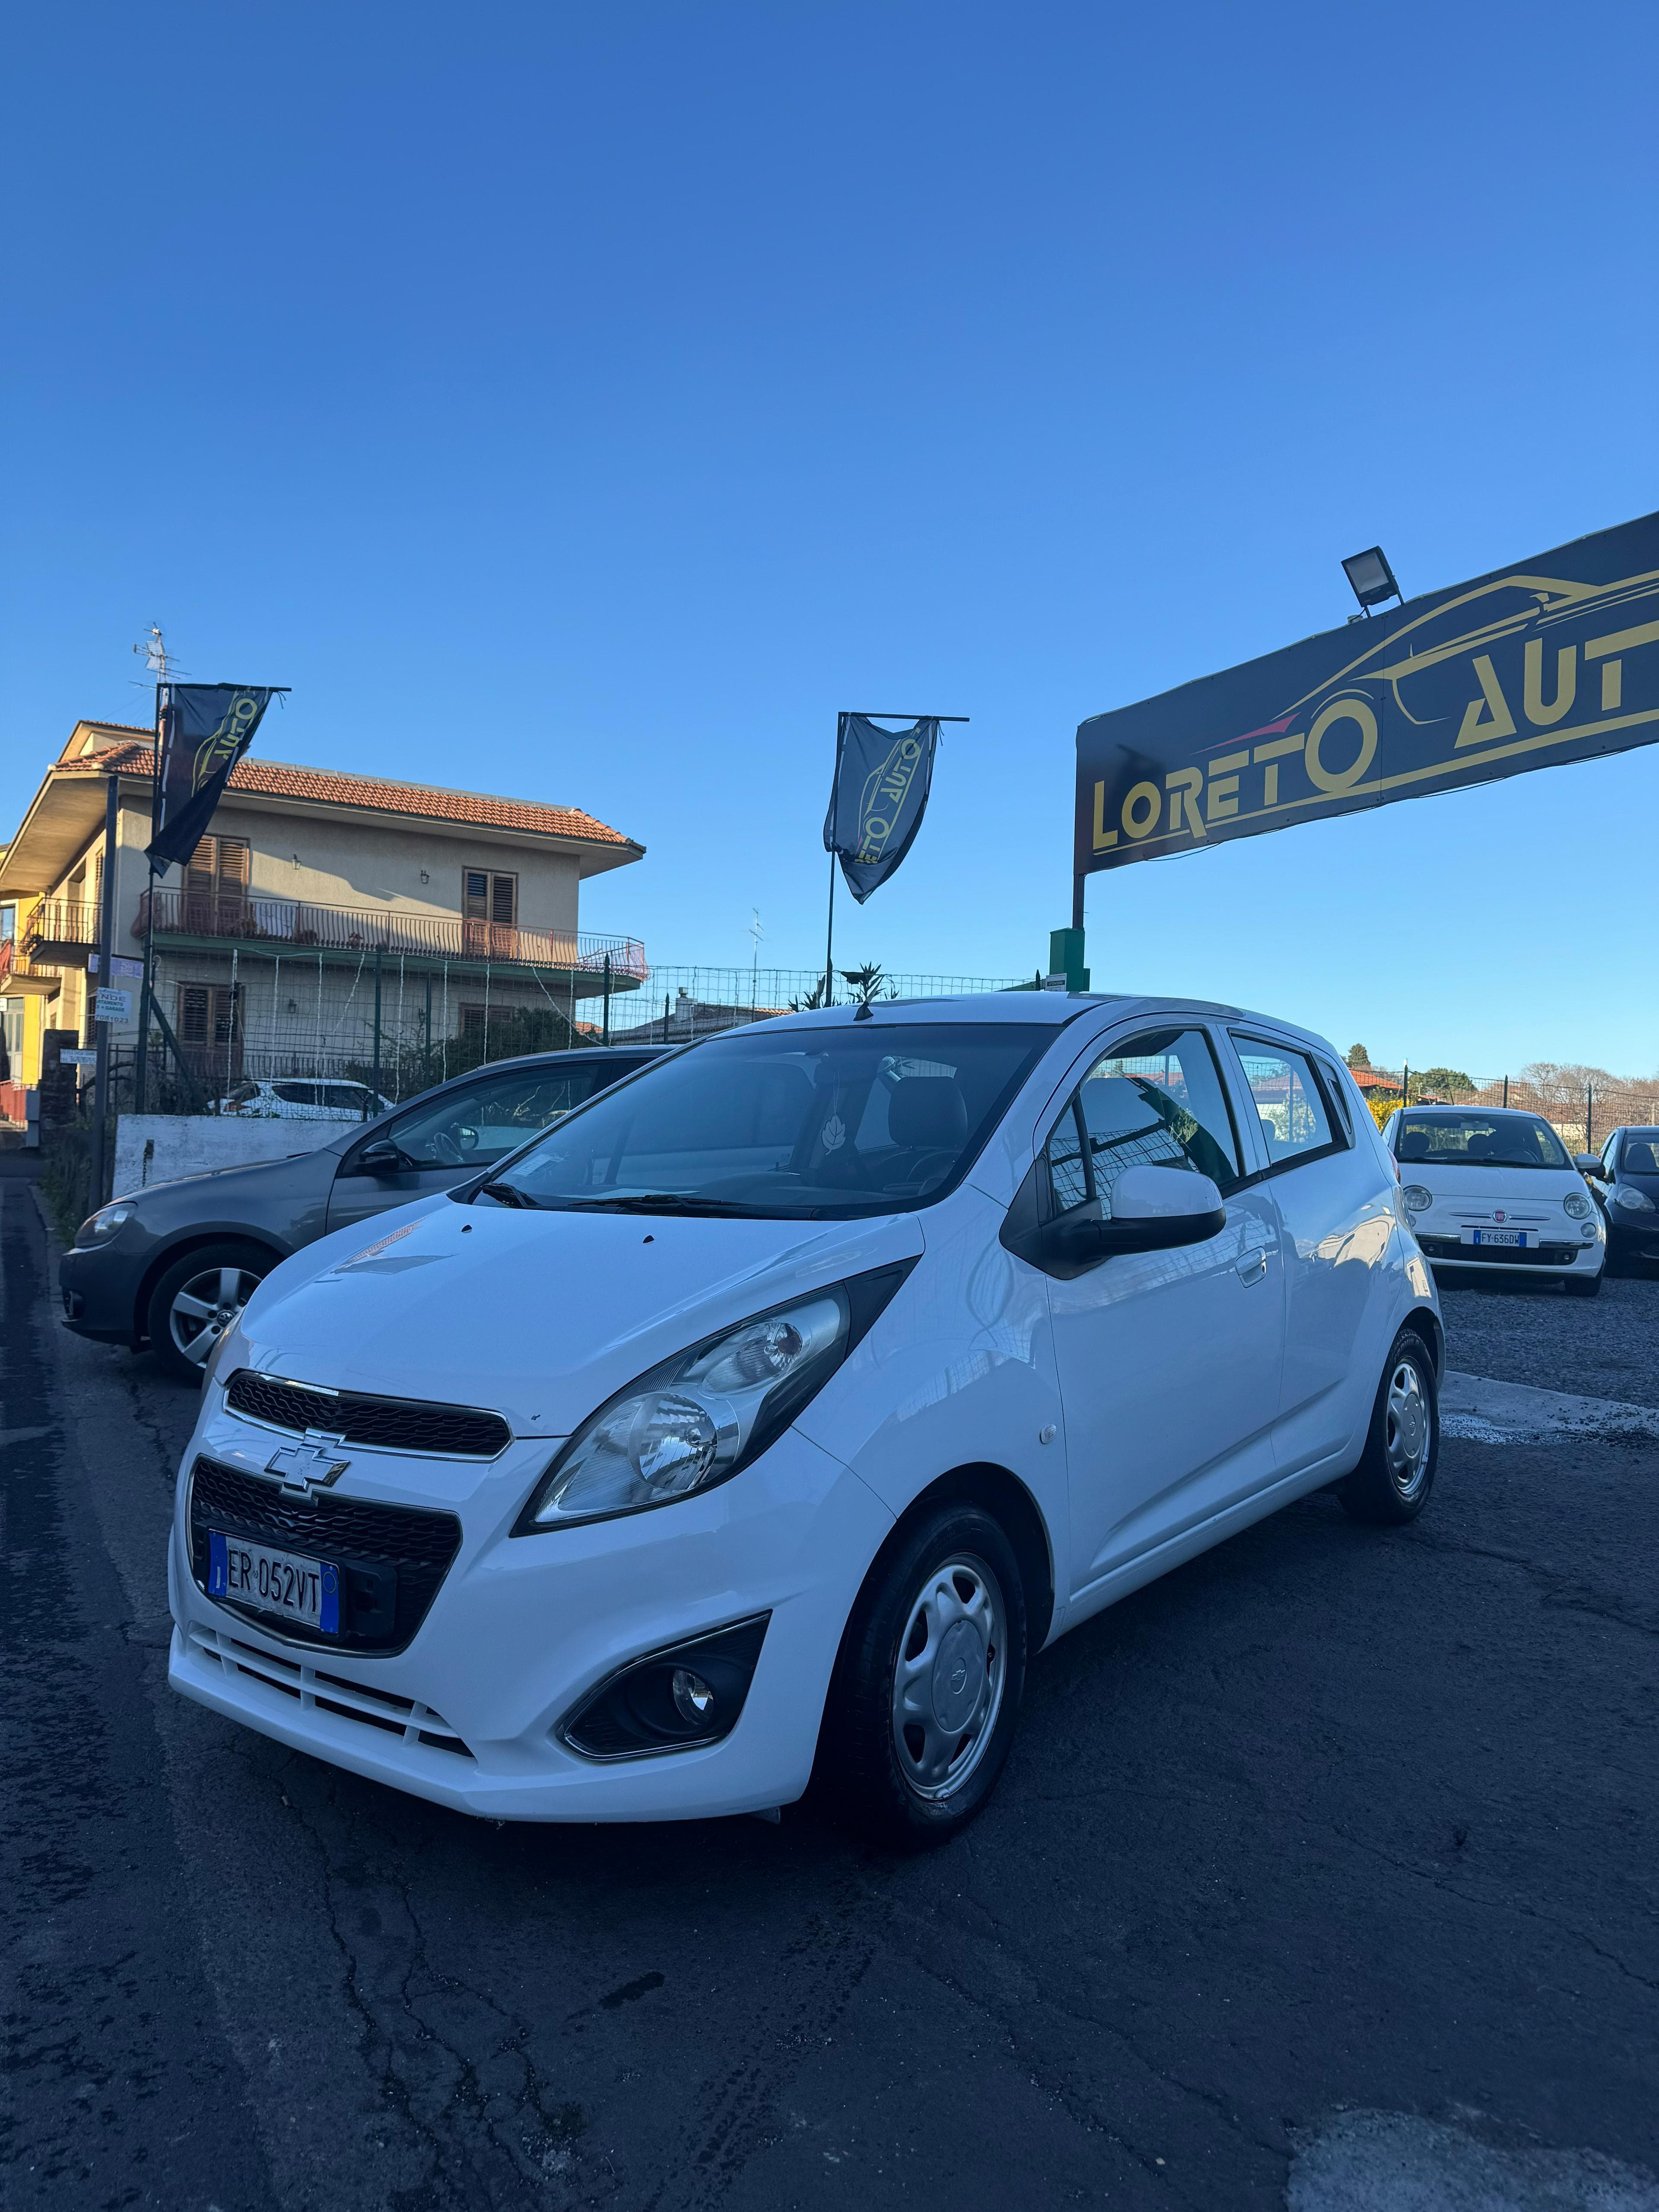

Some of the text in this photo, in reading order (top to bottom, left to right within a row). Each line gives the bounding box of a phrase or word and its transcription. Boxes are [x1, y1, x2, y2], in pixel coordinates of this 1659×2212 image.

[1093, 619, 1659, 839] LORETO AUT
[880, 738, 921, 804] AUTO
[1482, 1233, 1491, 1243] FY
[1494, 1234, 1519, 1244] 636DW
[228, 1548, 252, 1591] ER
[259, 1558, 320, 1614] 052VT
